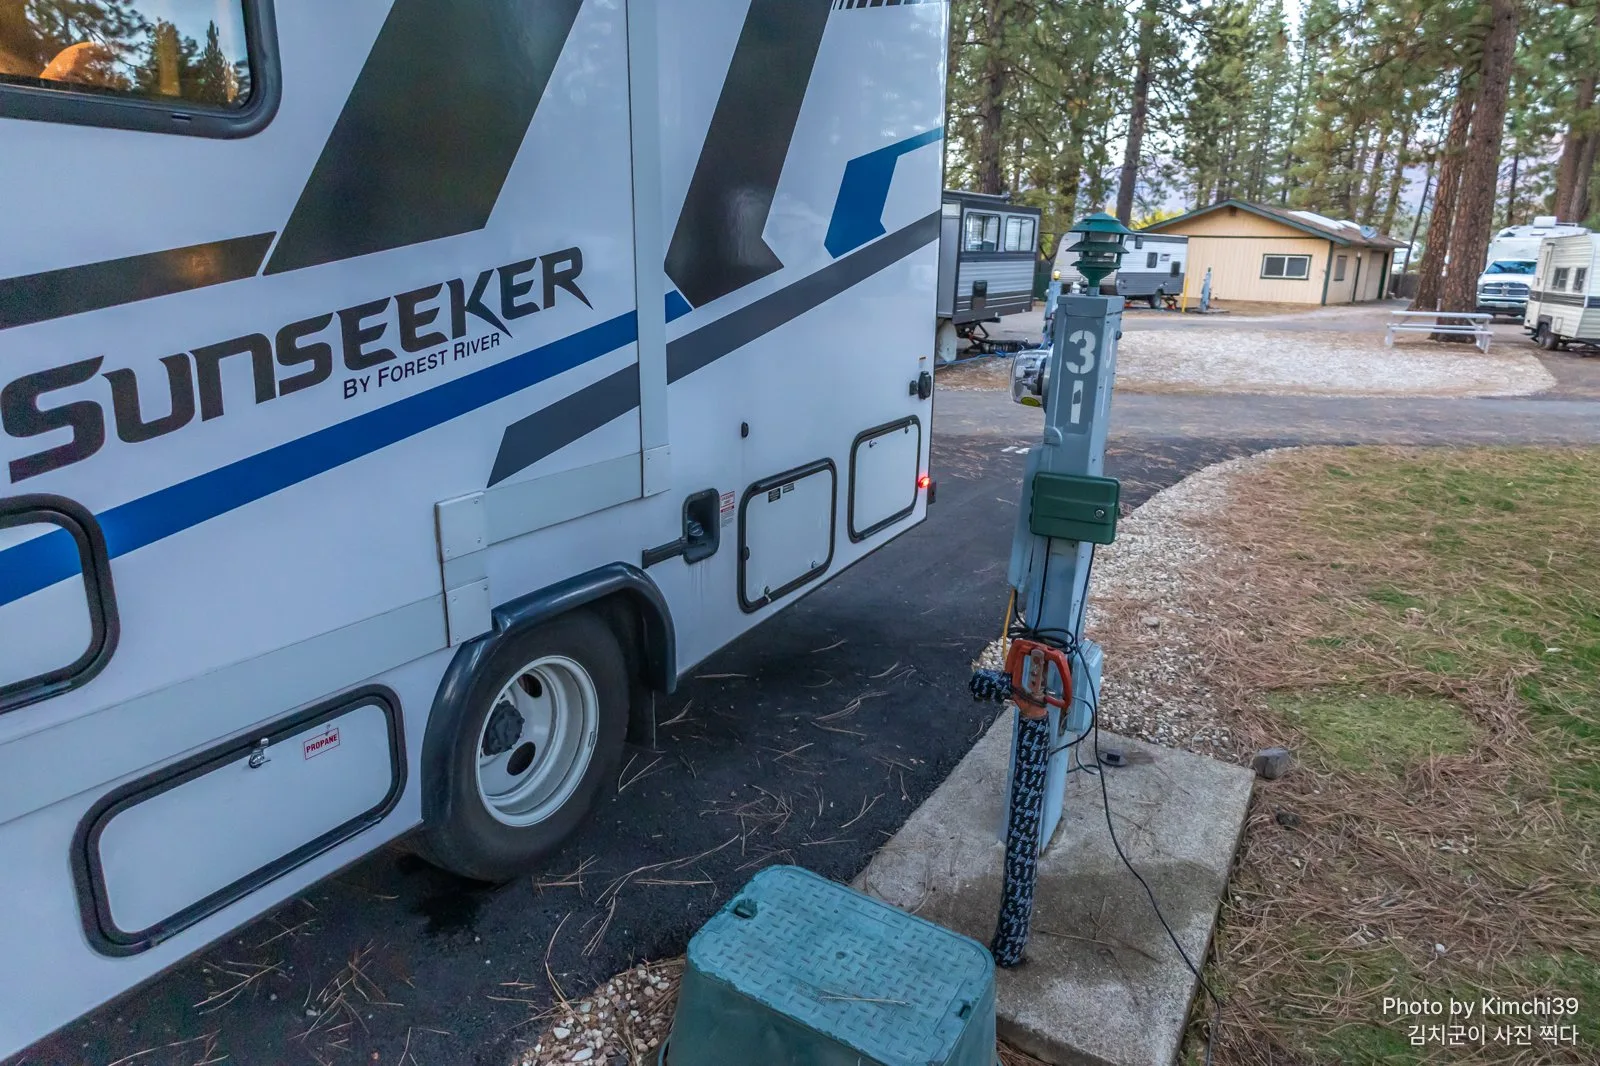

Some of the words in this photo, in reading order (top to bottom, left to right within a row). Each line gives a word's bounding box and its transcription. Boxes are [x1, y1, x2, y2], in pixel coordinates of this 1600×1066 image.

[1, 246, 594, 484] SUNSEEKER
[344, 376, 370, 400] BY
[378, 349, 448, 388] FOREST
[453, 332, 500, 361] RIVER
[306, 734, 338, 753] PROPANE
